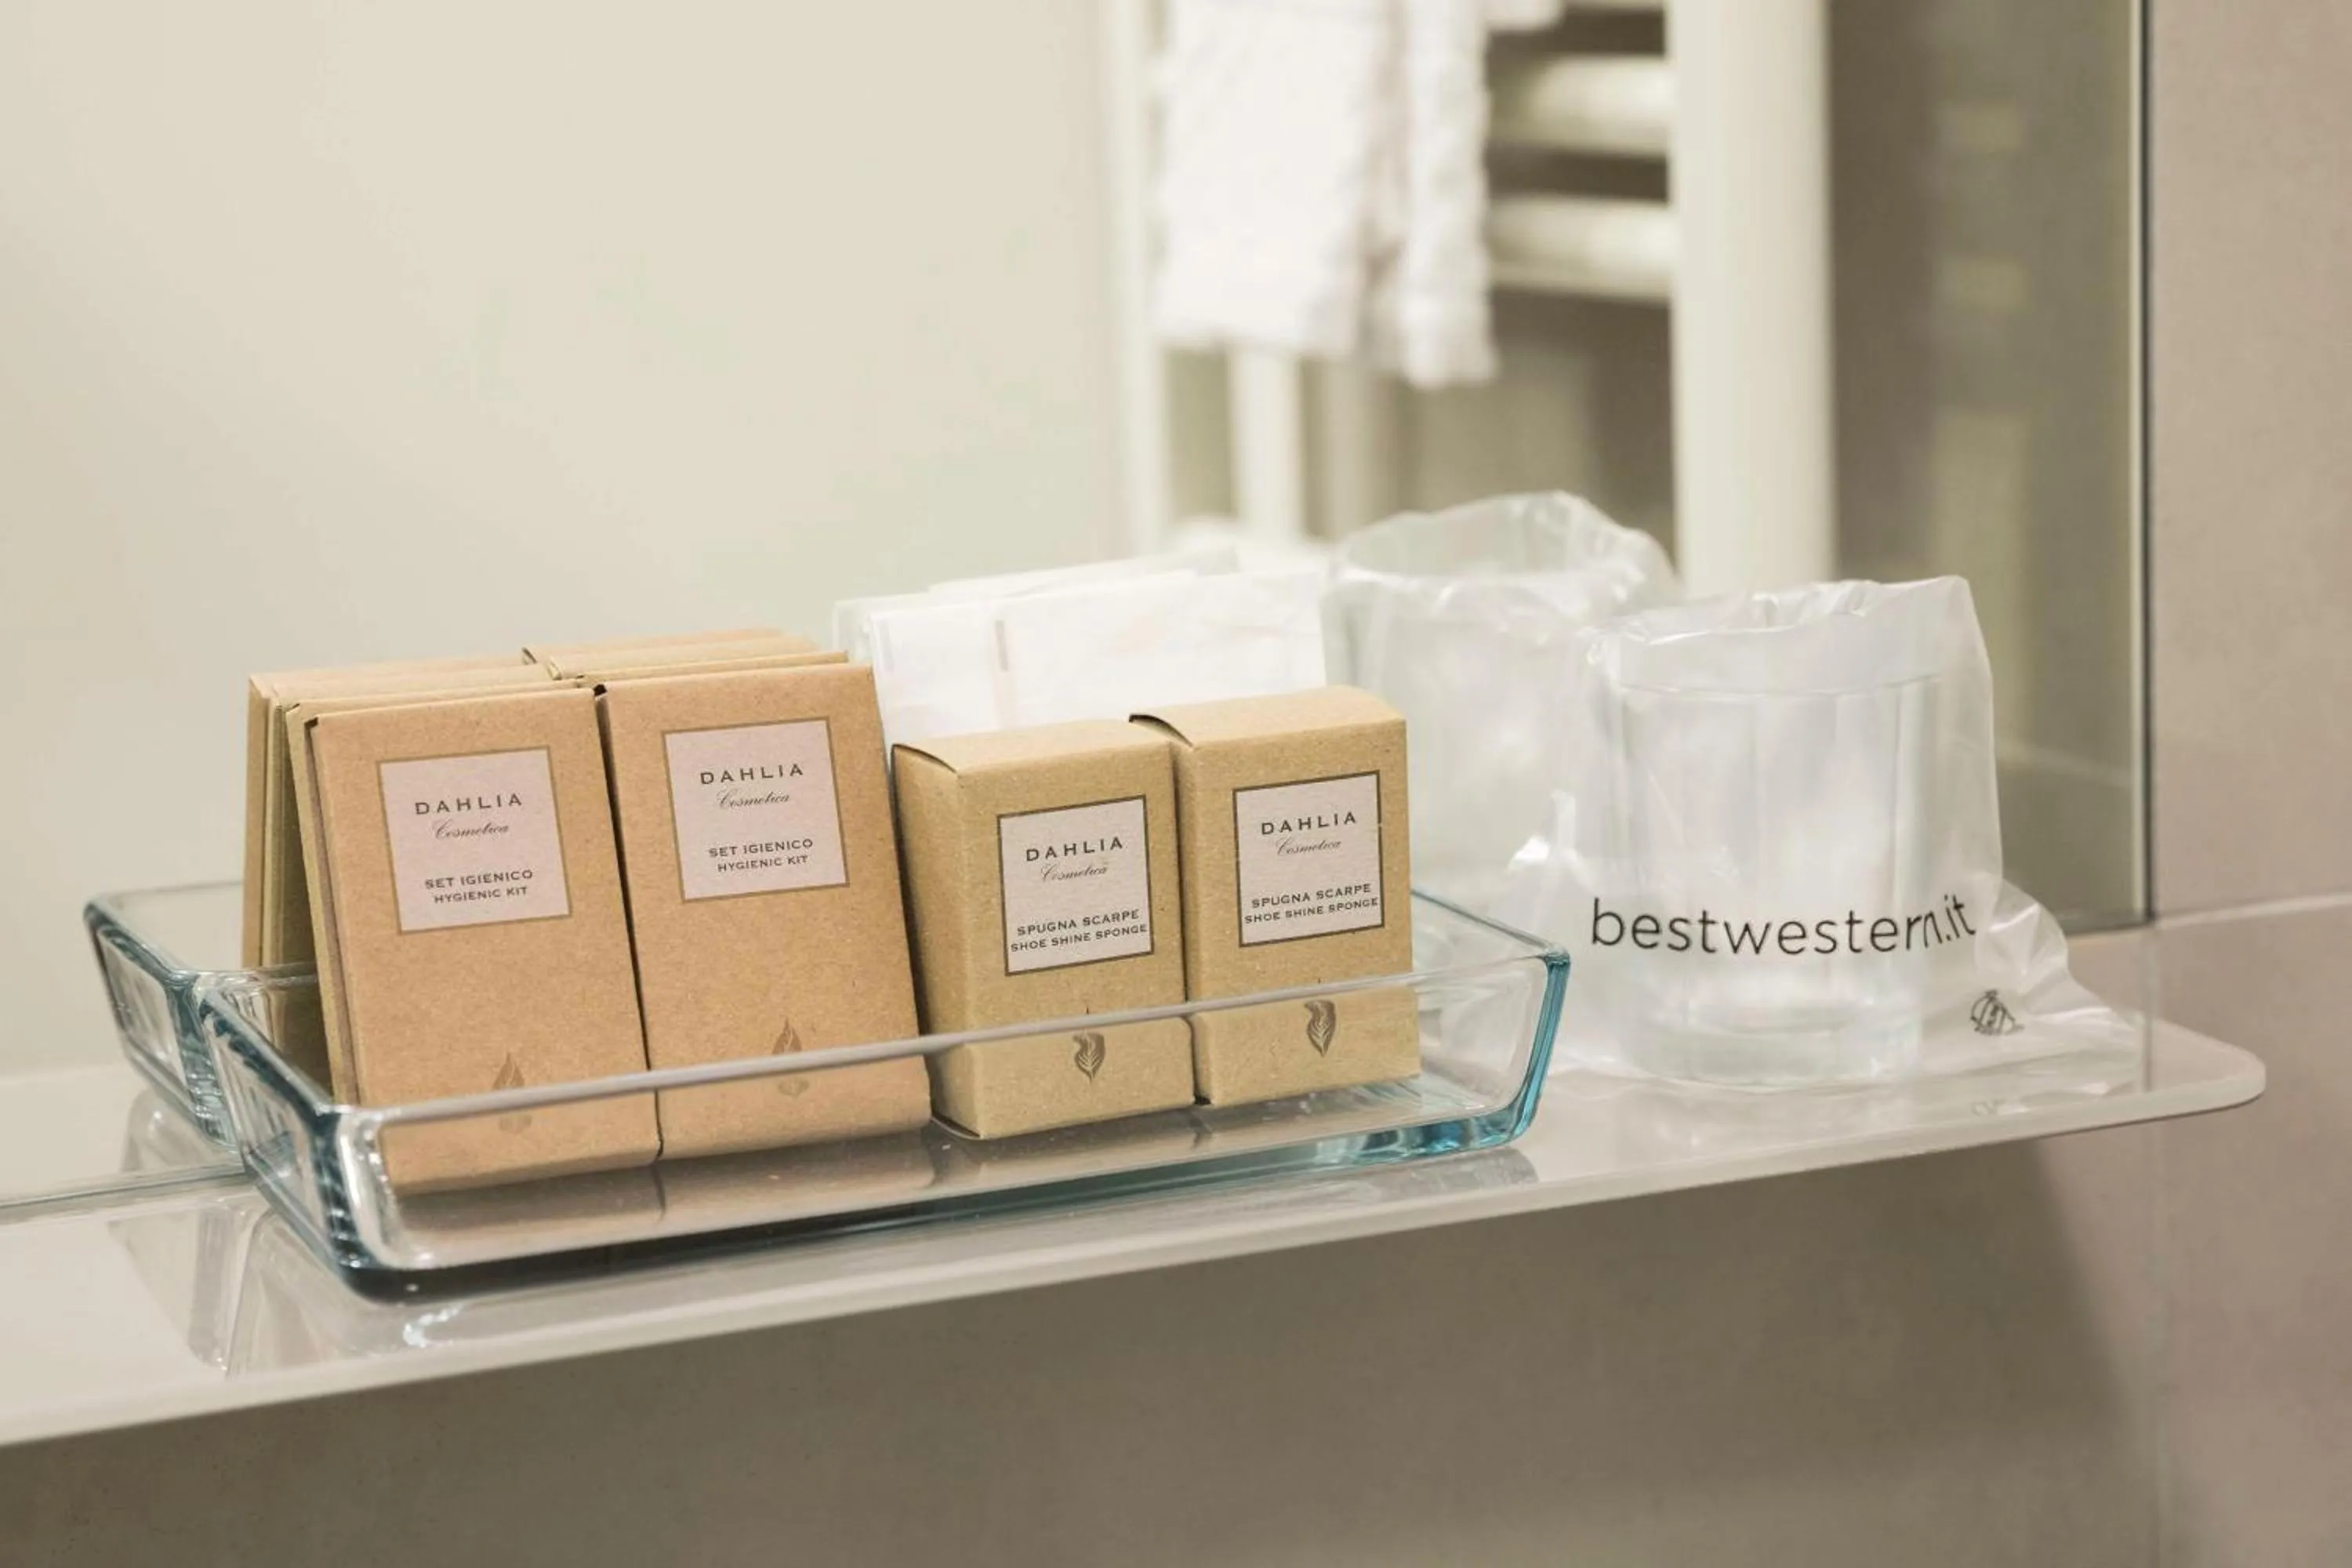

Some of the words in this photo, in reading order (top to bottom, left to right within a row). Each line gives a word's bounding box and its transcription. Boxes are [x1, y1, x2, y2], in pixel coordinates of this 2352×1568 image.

[700, 763, 804, 786] DAHLIA
[415, 793, 523, 815] DAHLIA
[432, 818, 509, 840] Cosmetica
[1261, 811, 1356, 836] DAHLIA
[708, 845, 738, 858] SET
[743, 838, 813, 855] IGIENICO
[1025, 836, 1123, 862] DAHLIA
[717, 857, 782, 873] HYGIENIC
[787, 855, 808, 866] KIT
[424, 877, 455, 890] SET
[459, 869, 533, 887] IGIENICO
[434, 887, 502, 904] HYGIENIC
[506, 885, 528, 897] KIT
[1251, 891, 1310, 909] SPUGNA
[1316, 883, 1371, 901] SCARPE
[1244, 911, 1281, 924] SHOE
[1285, 906, 1324, 919] SHINE
[1328, 897, 1378, 913] SPONGE
[1017, 919, 1077, 937] SPUGNA
[1082, 909, 1140, 927] SCARPE
[1591, 894, 1976, 955] bestwestern.it
[1011, 938, 1047, 953] SHOE
[1051, 932, 1091, 947] SHINE
[1094, 924, 1149, 940] SPONGE
